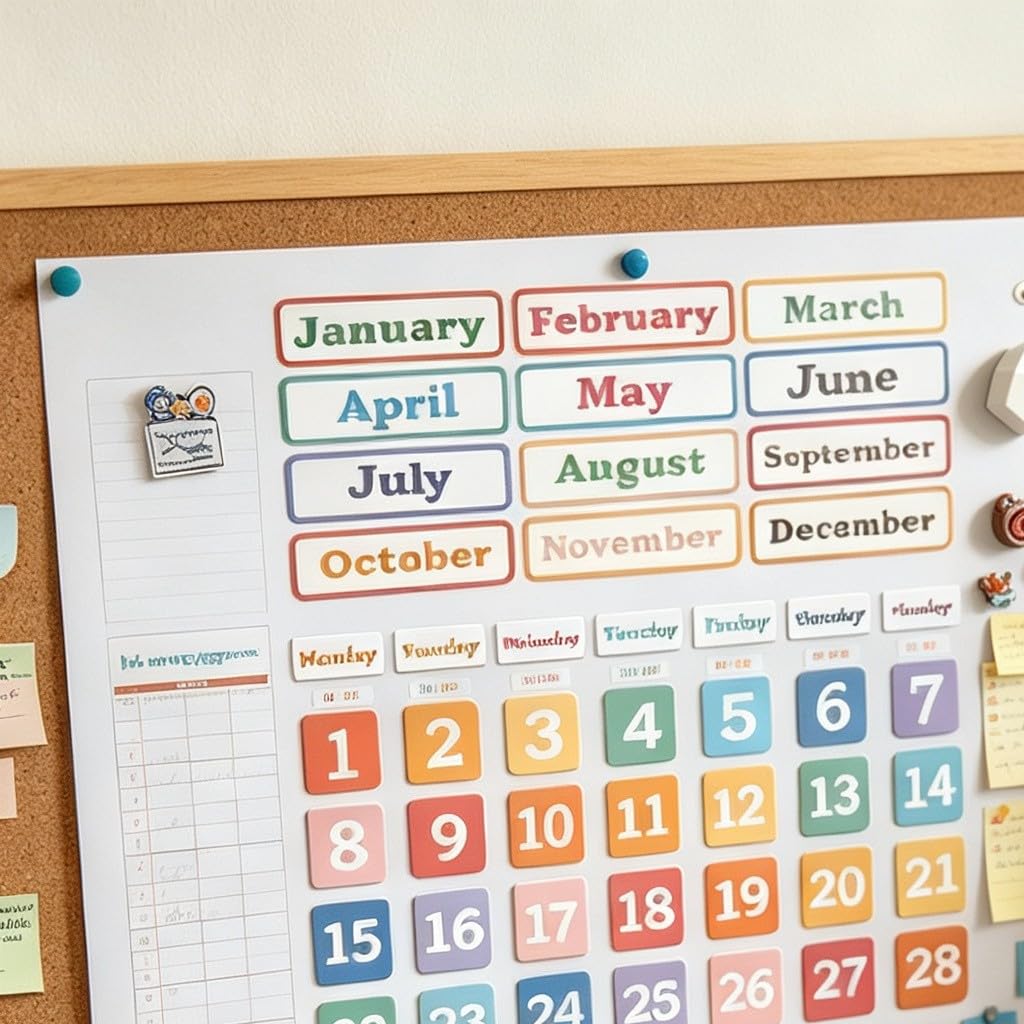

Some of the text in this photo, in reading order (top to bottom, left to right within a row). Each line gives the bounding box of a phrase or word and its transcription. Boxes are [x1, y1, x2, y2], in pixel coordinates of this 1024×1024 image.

[294, 291, 904, 348] January February March
[337, 364, 898, 430] April May June
[348, 462, 452, 503] July
[554, 448, 705, 489] August
[320, 510, 935, 579] October November December
[328, 729, 358, 780] 1
[427, 718, 463, 768] 2
[525, 709, 563, 760] 3
[623, 702, 662, 748] 4
[721, 692, 756, 741] 5
[817, 682, 850, 731] 6
[910, 674, 944, 725] 7
[330, 764, 956, 871] 8 9 10 11 12 13 14
[324, 853, 958, 965] 15 16 17 18 19 20 21
[623, 980, 680, 1024] 25
[720, 968, 774, 1012] 26
[814, 956, 867, 1000] 27
[906, 944, 961, 989] 28
